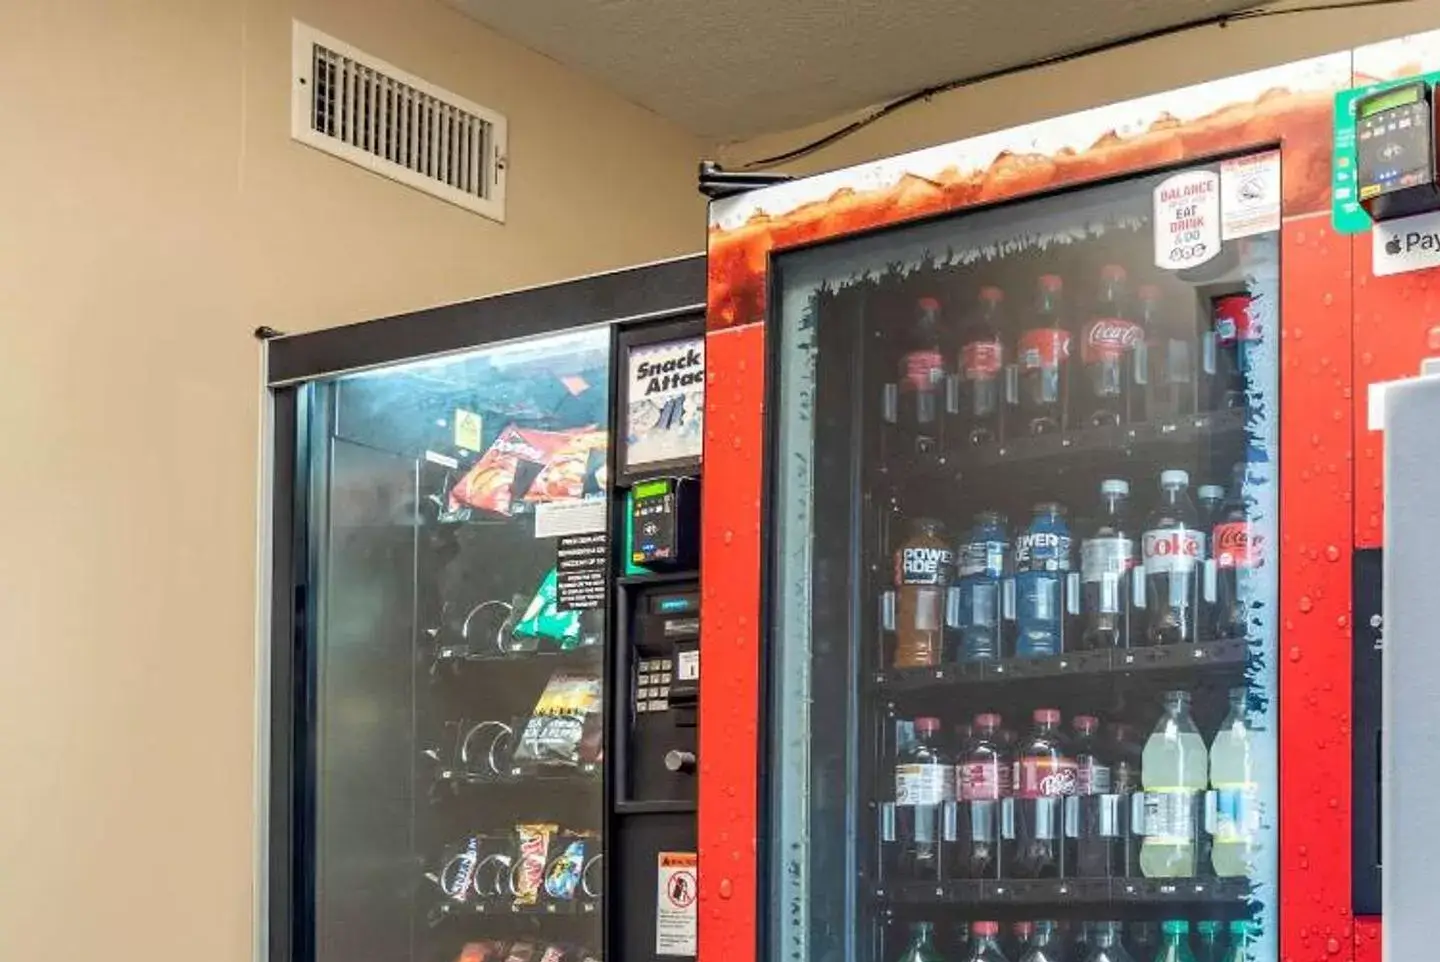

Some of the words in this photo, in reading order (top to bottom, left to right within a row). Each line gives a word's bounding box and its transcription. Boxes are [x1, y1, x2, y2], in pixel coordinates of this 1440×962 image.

[1161, 180, 1214, 202] BALANCE
[1176, 205, 1198, 220] EAT
[1170, 217, 1204, 234] DRINK
[637, 349, 701, 380] Snack
[645, 370, 703, 396] Attac
[1147, 534, 1198, 558] Coke
